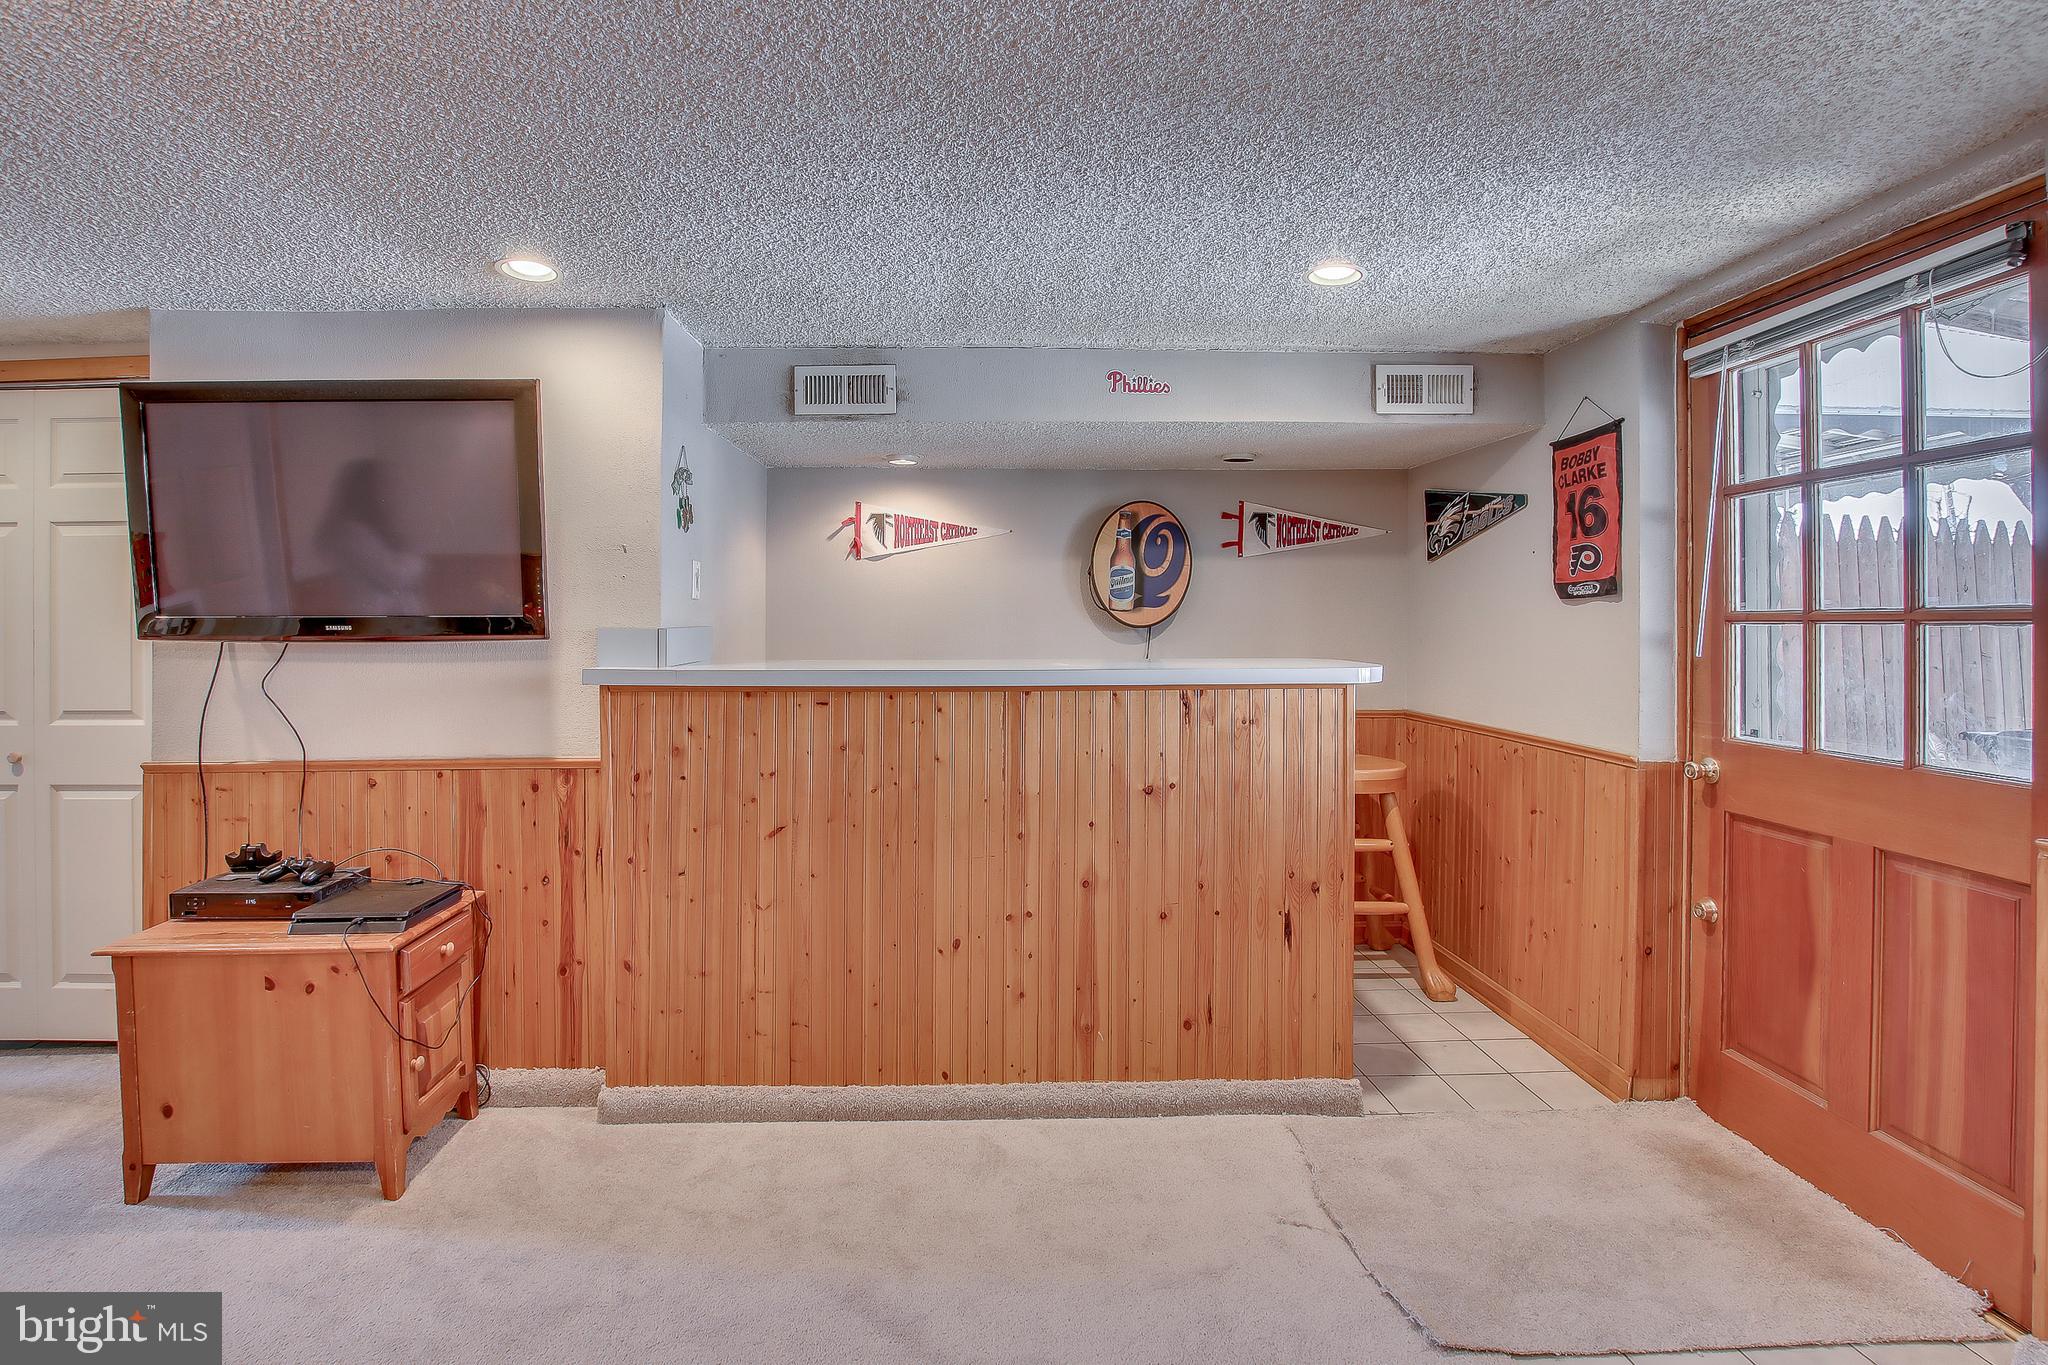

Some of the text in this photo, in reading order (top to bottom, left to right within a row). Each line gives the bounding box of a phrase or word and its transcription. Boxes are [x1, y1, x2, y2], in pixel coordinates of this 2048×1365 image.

[1106, 371, 1171, 394] Phillies
[1560, 446, 1600, 471] BOBBY
[1558, 462, 1608, 488] CLARKE
[1565, 484, 1609, 540] 16
[894, 513, 978, 549] NORTHEAST CATHOLIC
[1276, 513, 1359, 548] NORTHEAST CATHOLIC
